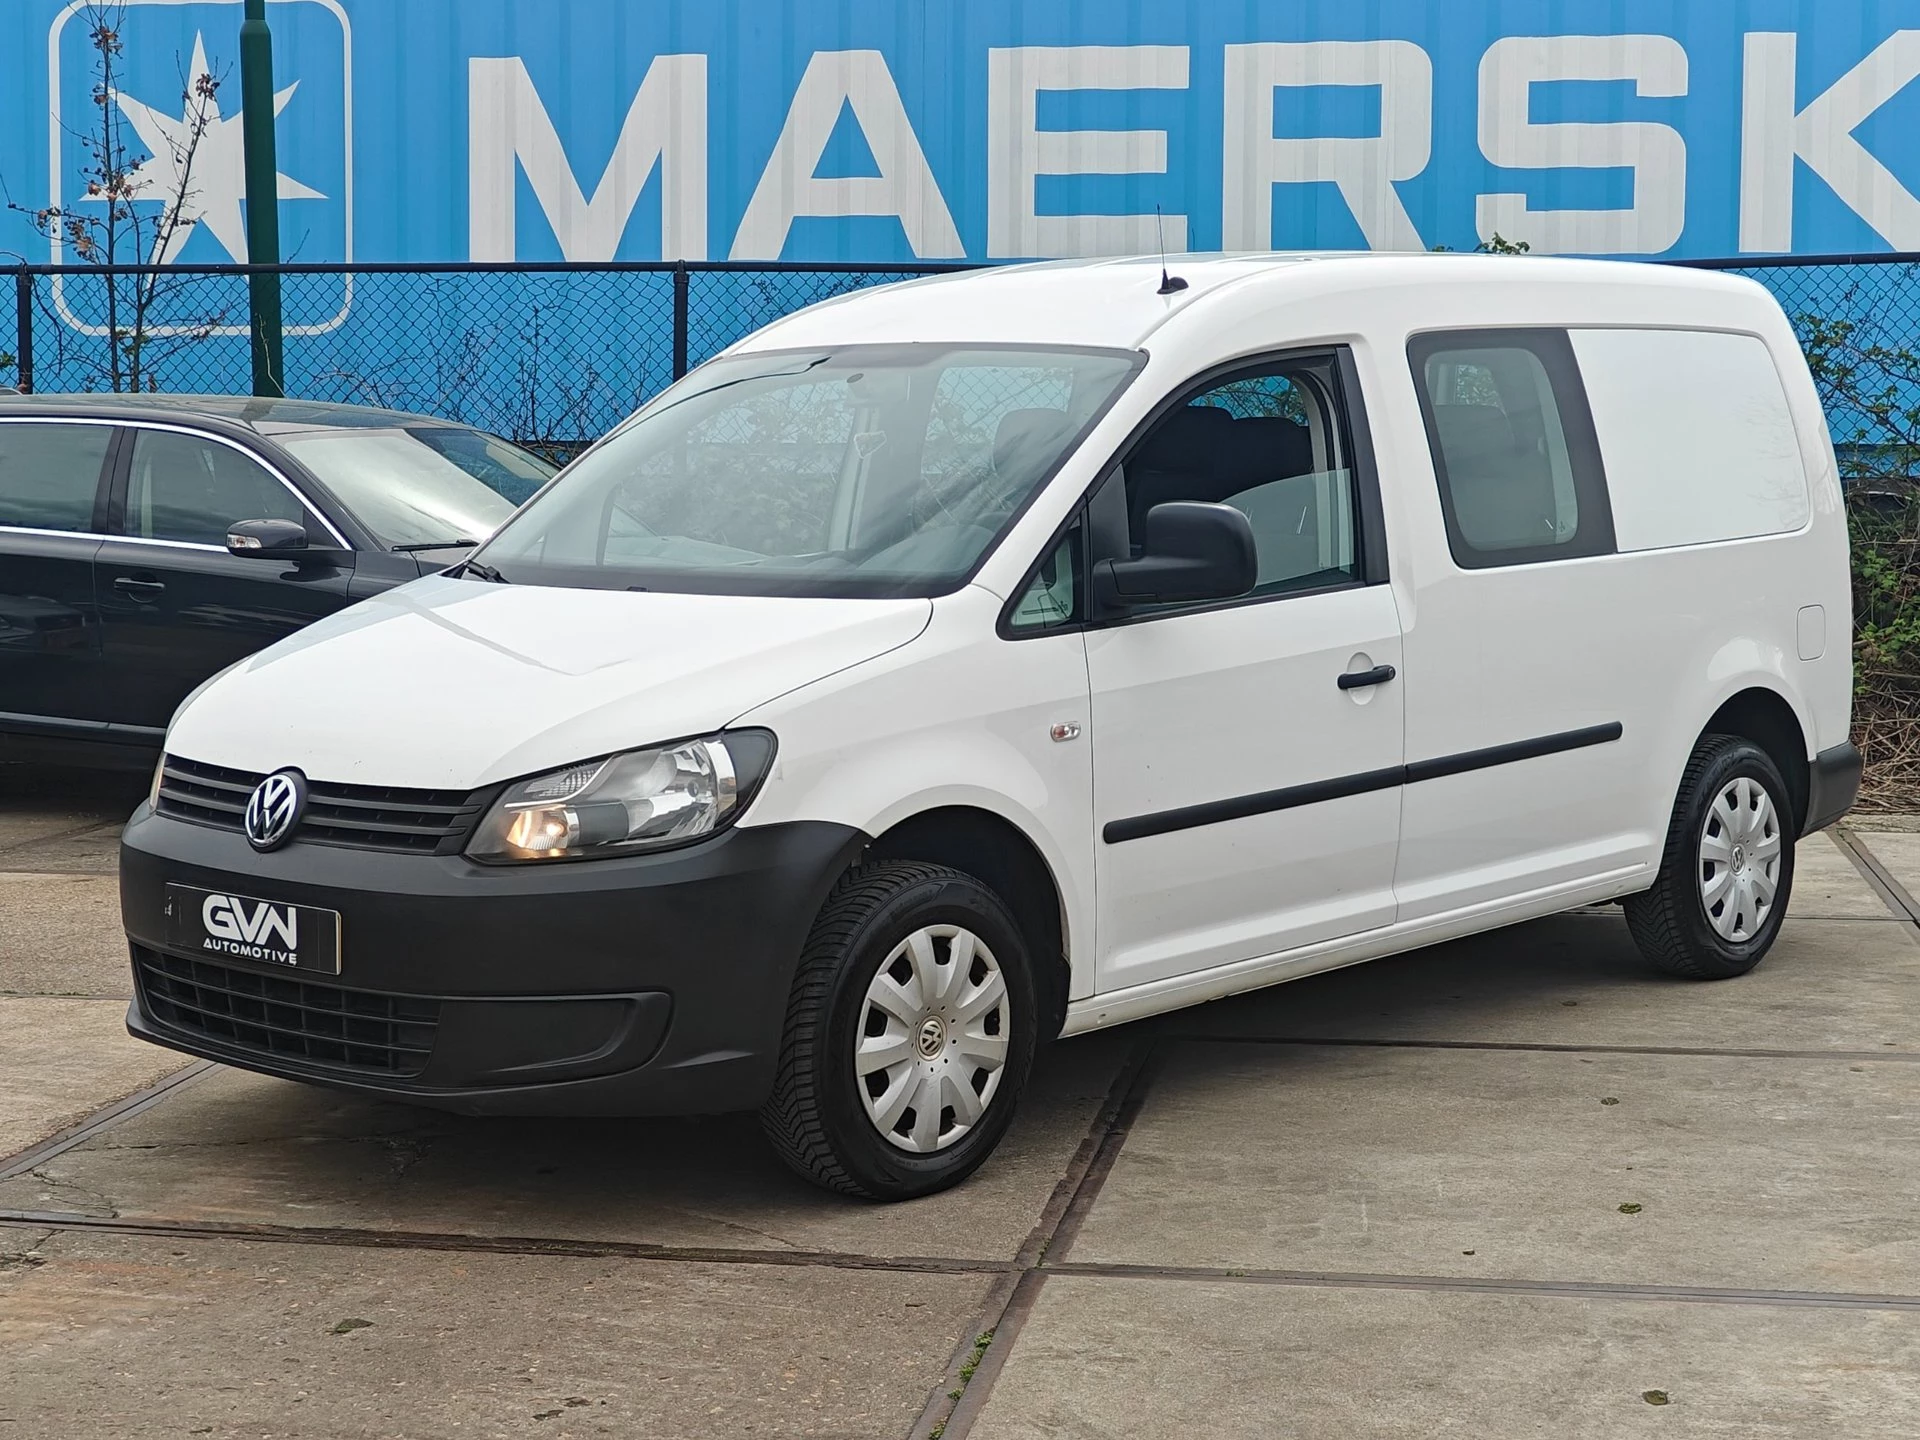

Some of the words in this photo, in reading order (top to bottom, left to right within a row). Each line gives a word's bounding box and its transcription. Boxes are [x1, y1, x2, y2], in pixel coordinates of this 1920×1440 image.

[467, 29, 1920, 263] MAERSK
[202, 893, 297, 951] GVN
[202, 936, 298, 966] AUTOMOTIVE
